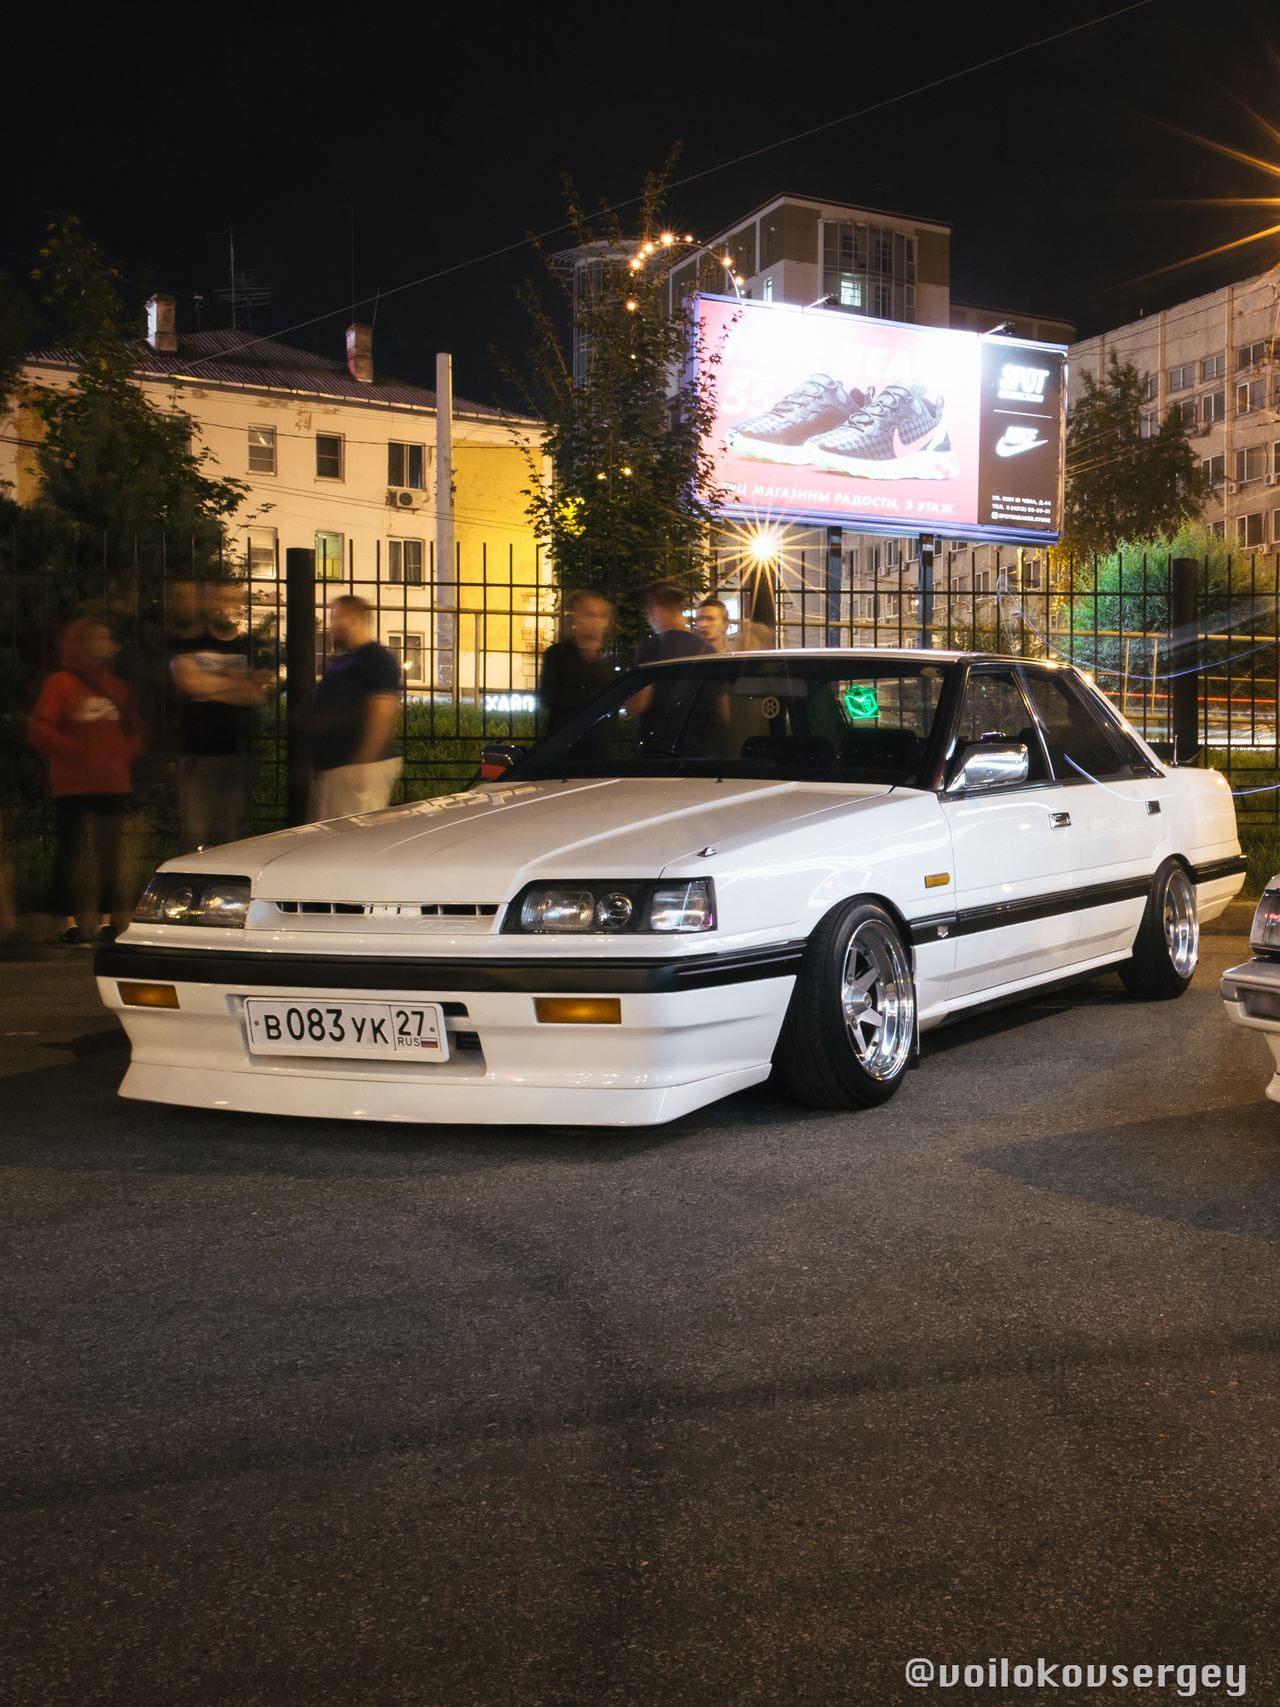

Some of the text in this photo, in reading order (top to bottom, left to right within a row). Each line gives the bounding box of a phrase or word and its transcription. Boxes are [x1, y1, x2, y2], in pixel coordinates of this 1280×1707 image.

[999, 363, 1049, 393] SPOT
[752, 485, 830, 503] МАГАЗИНЫ
[834, 492, 901, 511] РАДОСТИ,
[905, 499, 913, 510] 3
[917, 501, 954, 515] ЭТАЖ
[485, 693, 535, 712] ХАЙП
[395, 1010, 425, 1036] 27
[397, 1037, 421, 1047] RUS
